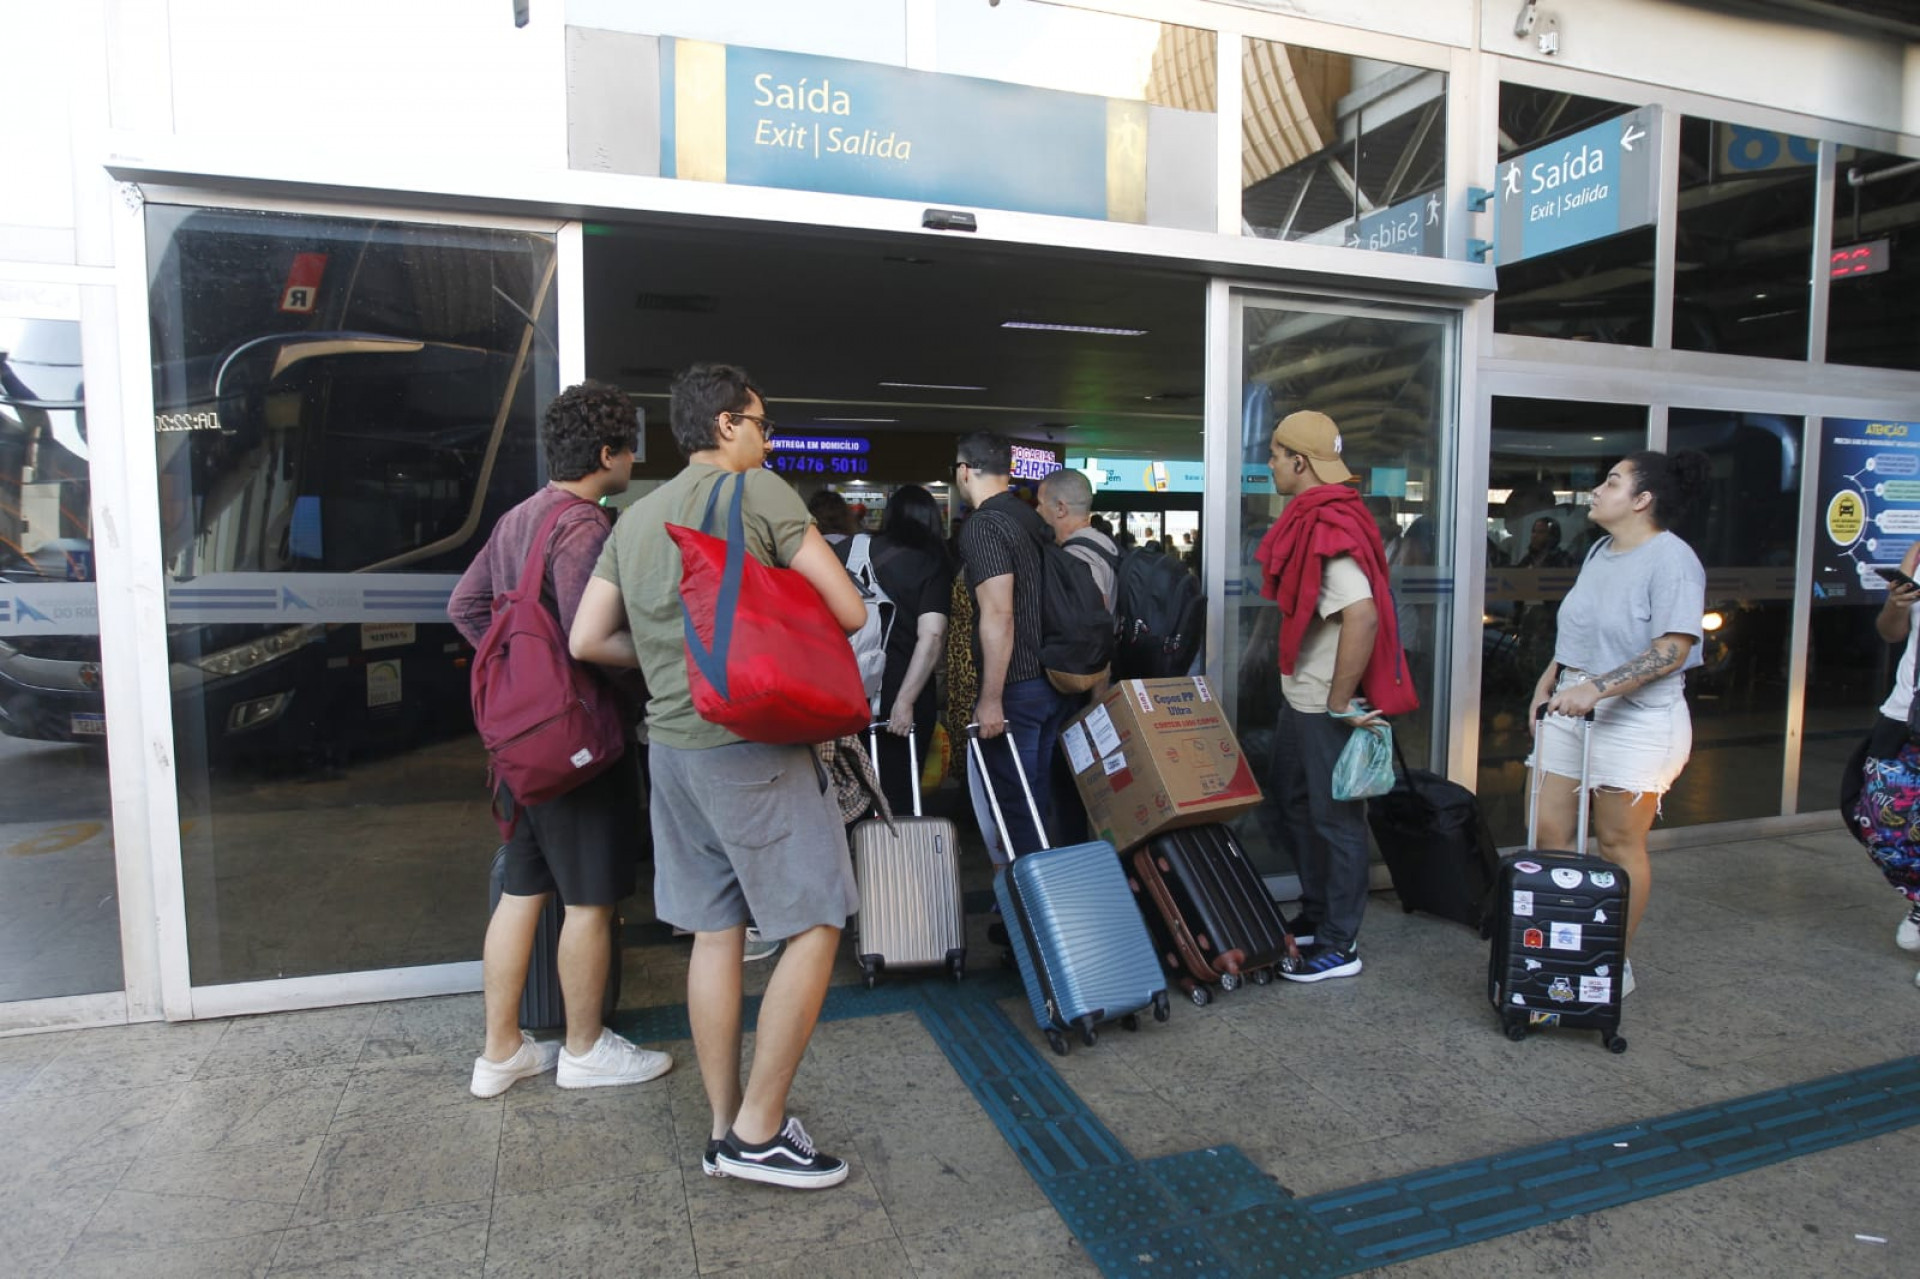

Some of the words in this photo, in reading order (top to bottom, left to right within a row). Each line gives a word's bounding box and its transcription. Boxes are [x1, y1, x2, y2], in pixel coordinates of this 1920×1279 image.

[754, 73, 850, 116] Saída
[755, 119, 807, 149] Exit
[826, 127, 912, 160] Salida
[1531, 145, 1603, 194] Saída
[1530, 201, 1555, 222] Exit
[1563, 184, 1609, 211] Salida
[772, 440, 805, 449] ENTREGA
[807, 441, 819, 449] EM
[821, 440, 859, 450] DOMICÍLIO
[1011, 445, 1055, 461] ROGARIAS
